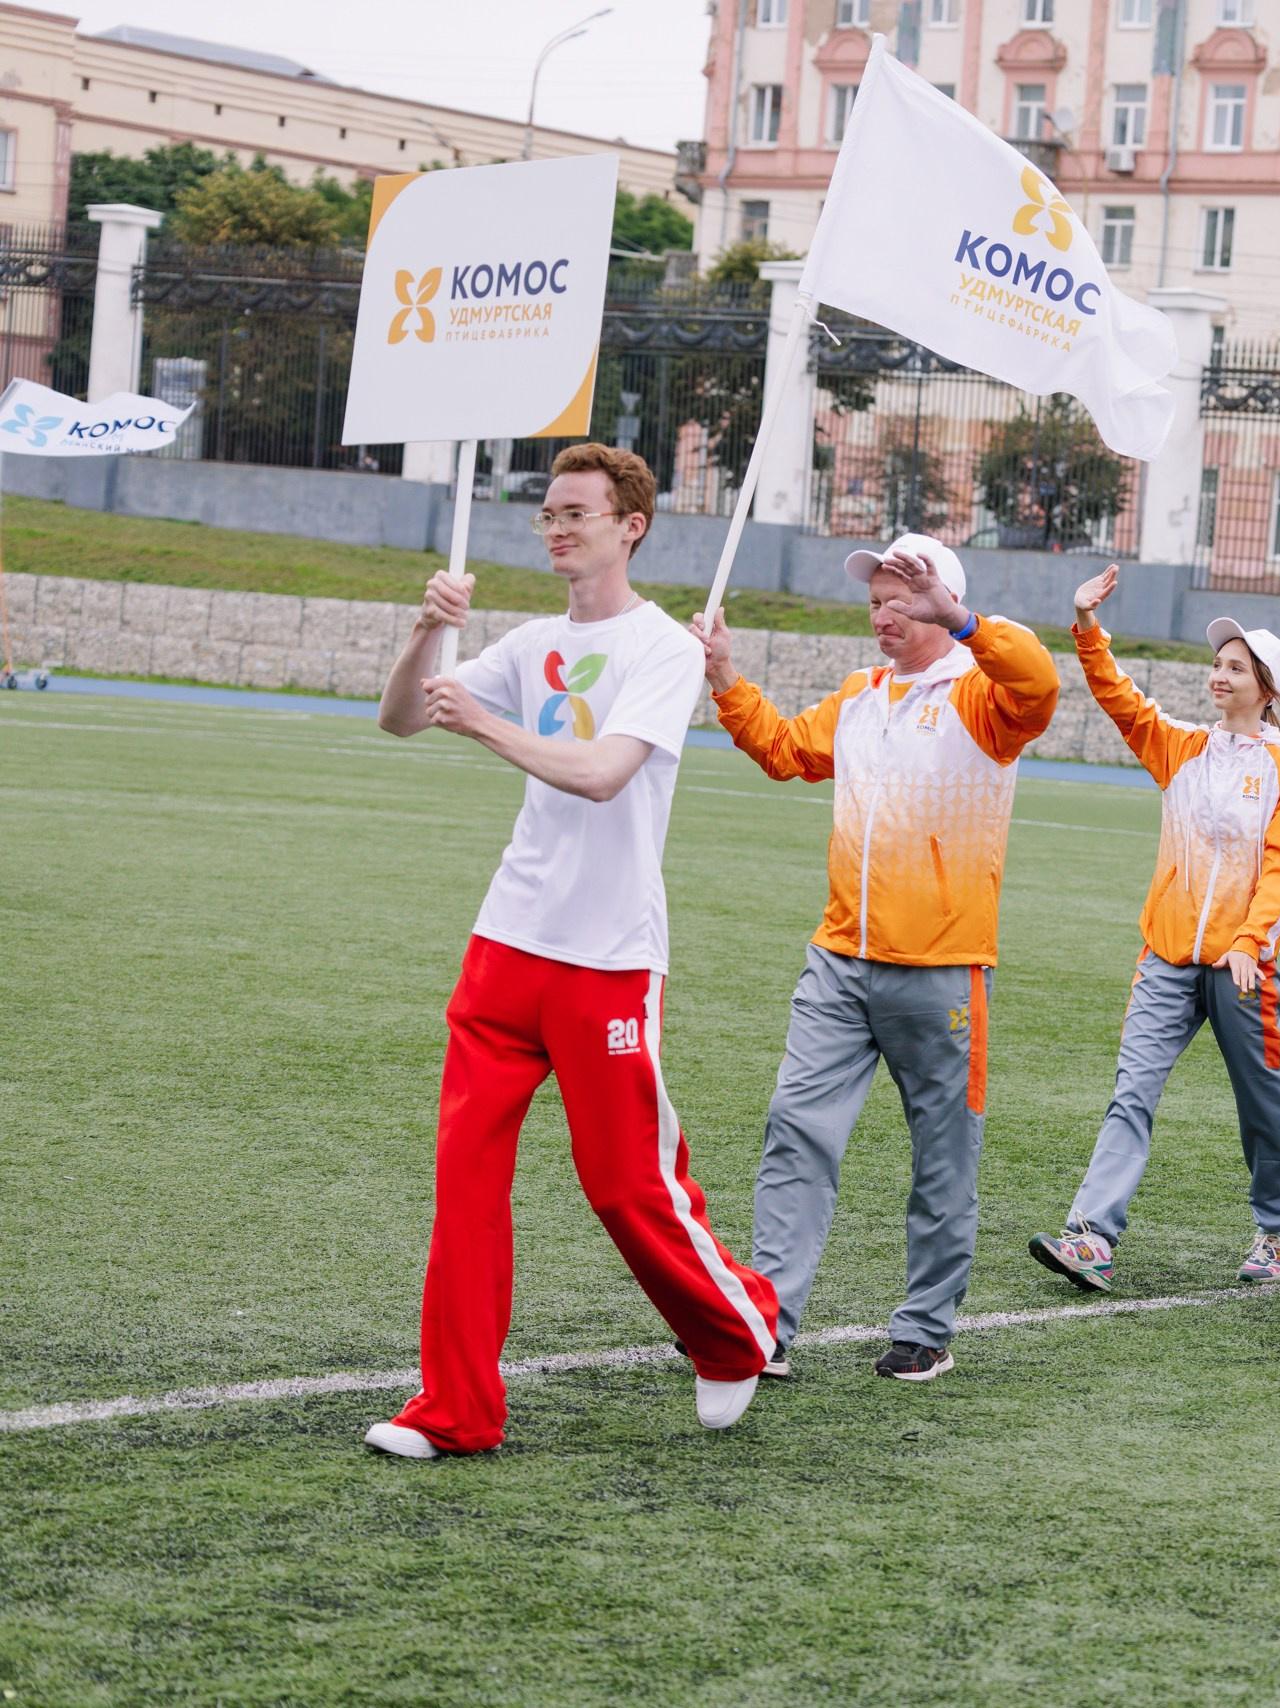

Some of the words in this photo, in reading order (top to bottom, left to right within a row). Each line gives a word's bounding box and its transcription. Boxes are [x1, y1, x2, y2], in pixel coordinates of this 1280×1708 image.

[451, 259, 569, 299] КОМОС
[954, 229, 1101, 315] КОМОС
[449, 303, 552, 326] УДМУРТСКАЯ
[959, 272, 1081, 336] УДМУРТСКАЯ
[446, 327, 549, 342] ПТИЦЕФАБРИКА
[951, 294, 1071, 352] ПТИЦЕФАБРИКА
[67, 416, 176, 438] КОМОС
[607, 1017, 639, 1049] 20
